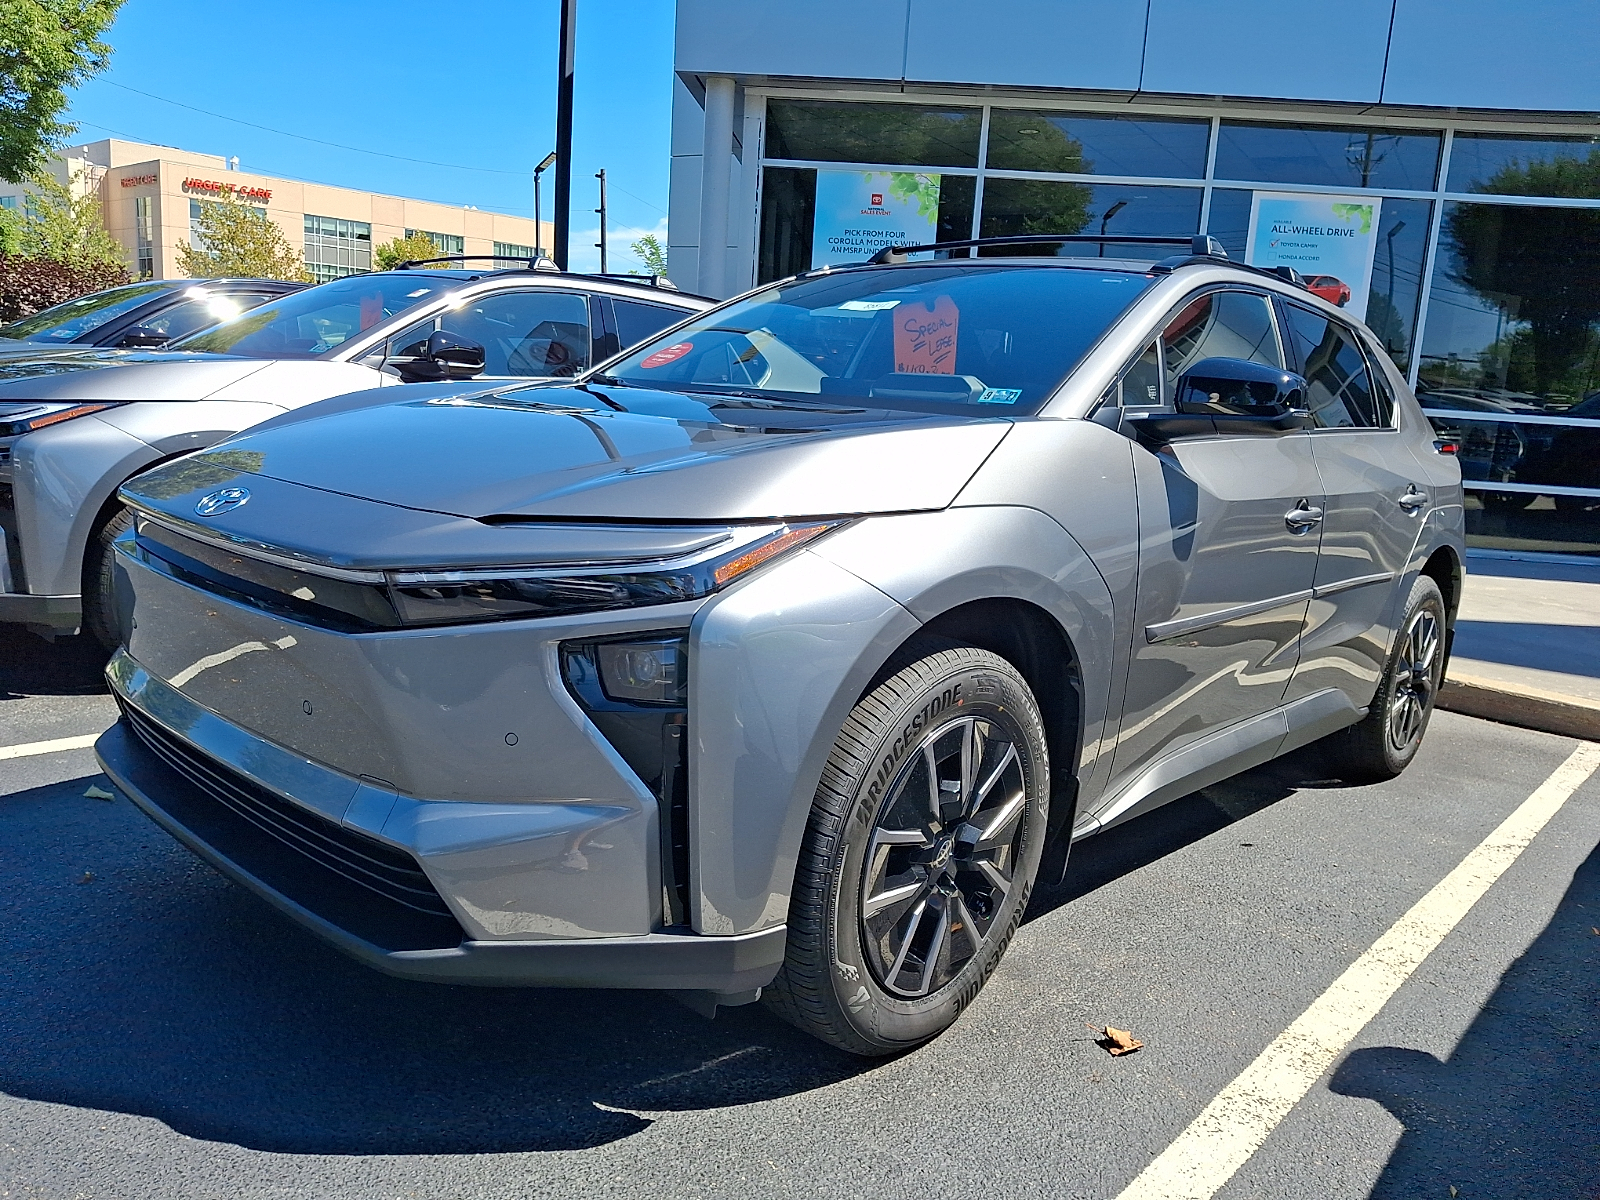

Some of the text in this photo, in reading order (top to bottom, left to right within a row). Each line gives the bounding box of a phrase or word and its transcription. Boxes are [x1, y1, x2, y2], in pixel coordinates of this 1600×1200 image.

[240, 185, 273, 199] CARE
[844, 229, 906, 239] PICK FROM FOUR
[1271, 224, 1355, 238] ALL-WHEEL DRIVE
[828, 237, 864, 245] COROLLA
[866, 239, 899, 247] MODELS
[830, 246, 842, 254] AN
[842, 246, 863, 254] MSRP
[1020, 692, 1050, 782] TURANZA
[856, 683, 962, 829] BRIDGESTONE
